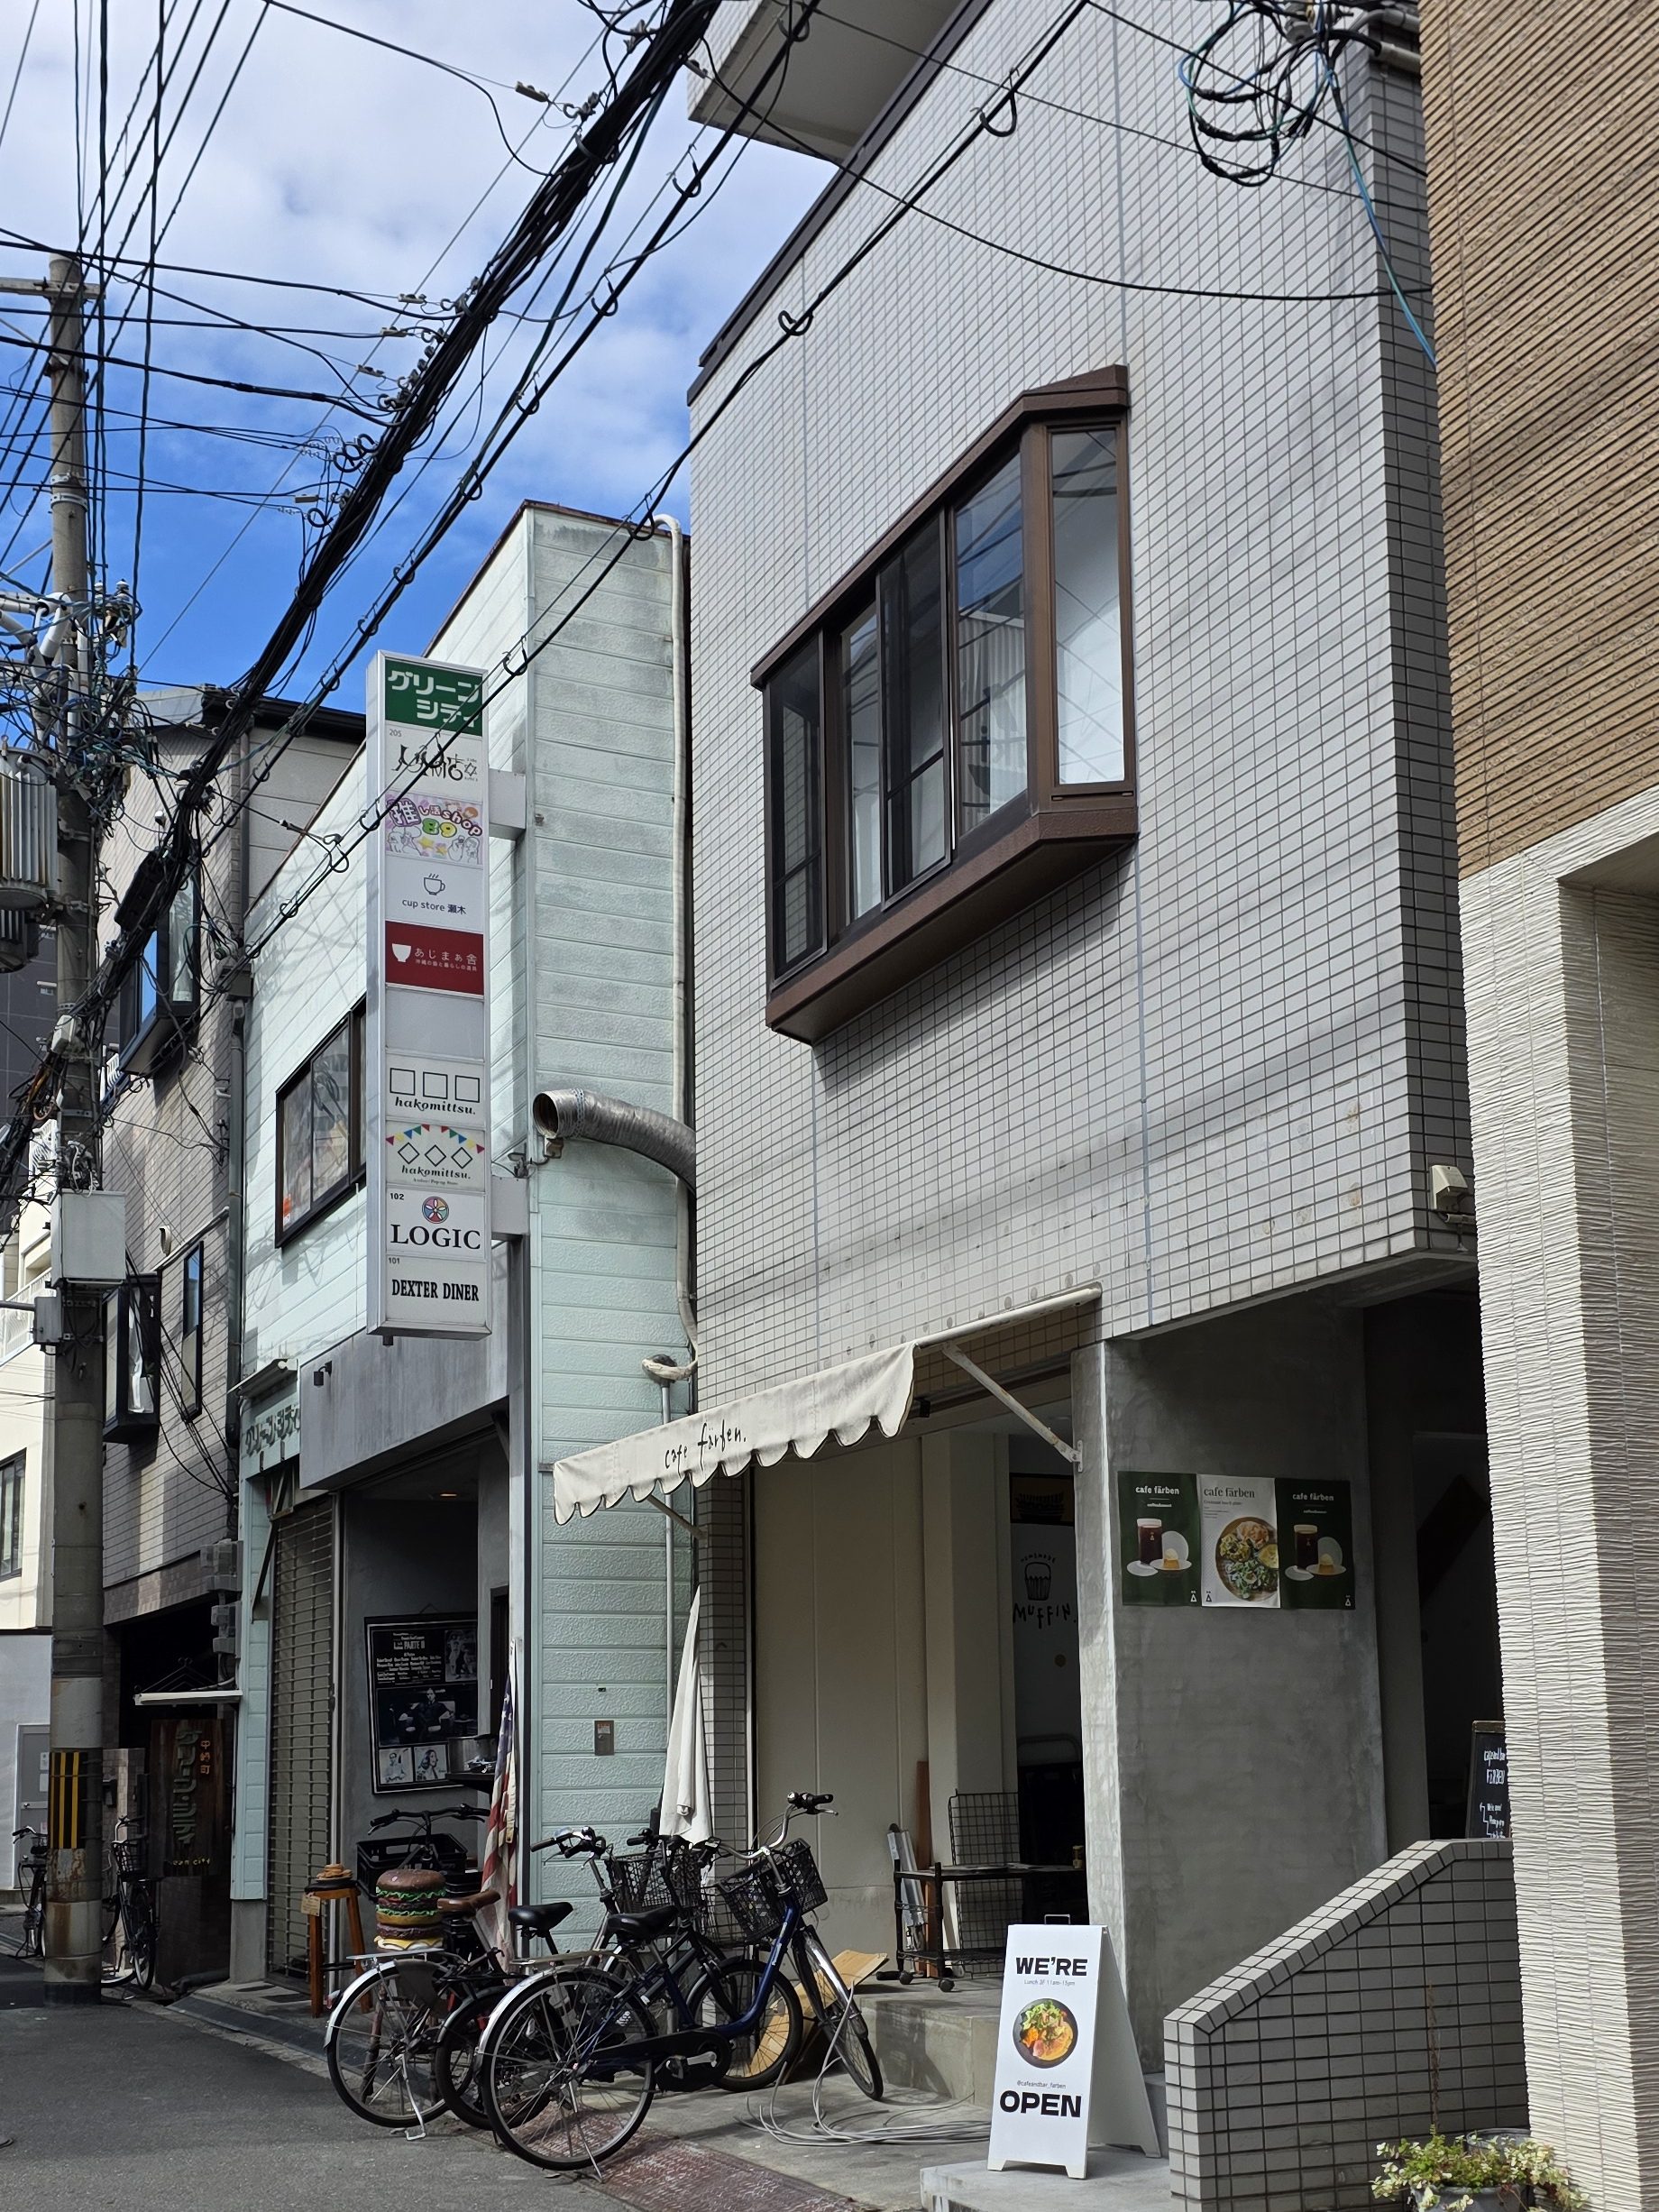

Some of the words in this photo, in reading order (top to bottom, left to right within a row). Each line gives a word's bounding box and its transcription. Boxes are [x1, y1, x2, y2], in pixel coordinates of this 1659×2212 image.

[388, 670, 480, 703] グリーン
[417, 699, 479, 728] シティ
[390, 729, 402, 738] 205
[402, 899, 418, 909] cup
[420, 901, 445, 912] store
[394, 1096, 476, 1115] hakomittsu.
[401, 1164, 472, 1179] hakomittsu.
[390, 1192, 405, 1200] 102
[390, 1224, 481, 1250] LOGIC
[388, 1257, 400, 1265] 101
[391, 1279, 438, 1299] DEXTER
[443, 1283, 480, 1301] DINER
[665, 1445, 687, 1479] cafe
[1135, 1484, 1152, 1494] cafe
[1203, 1487, 1224, 1497] cafe
[1292, 1492, 1308, 1501] cafe
[1000, 2089, 1082, 2118] OPEN
